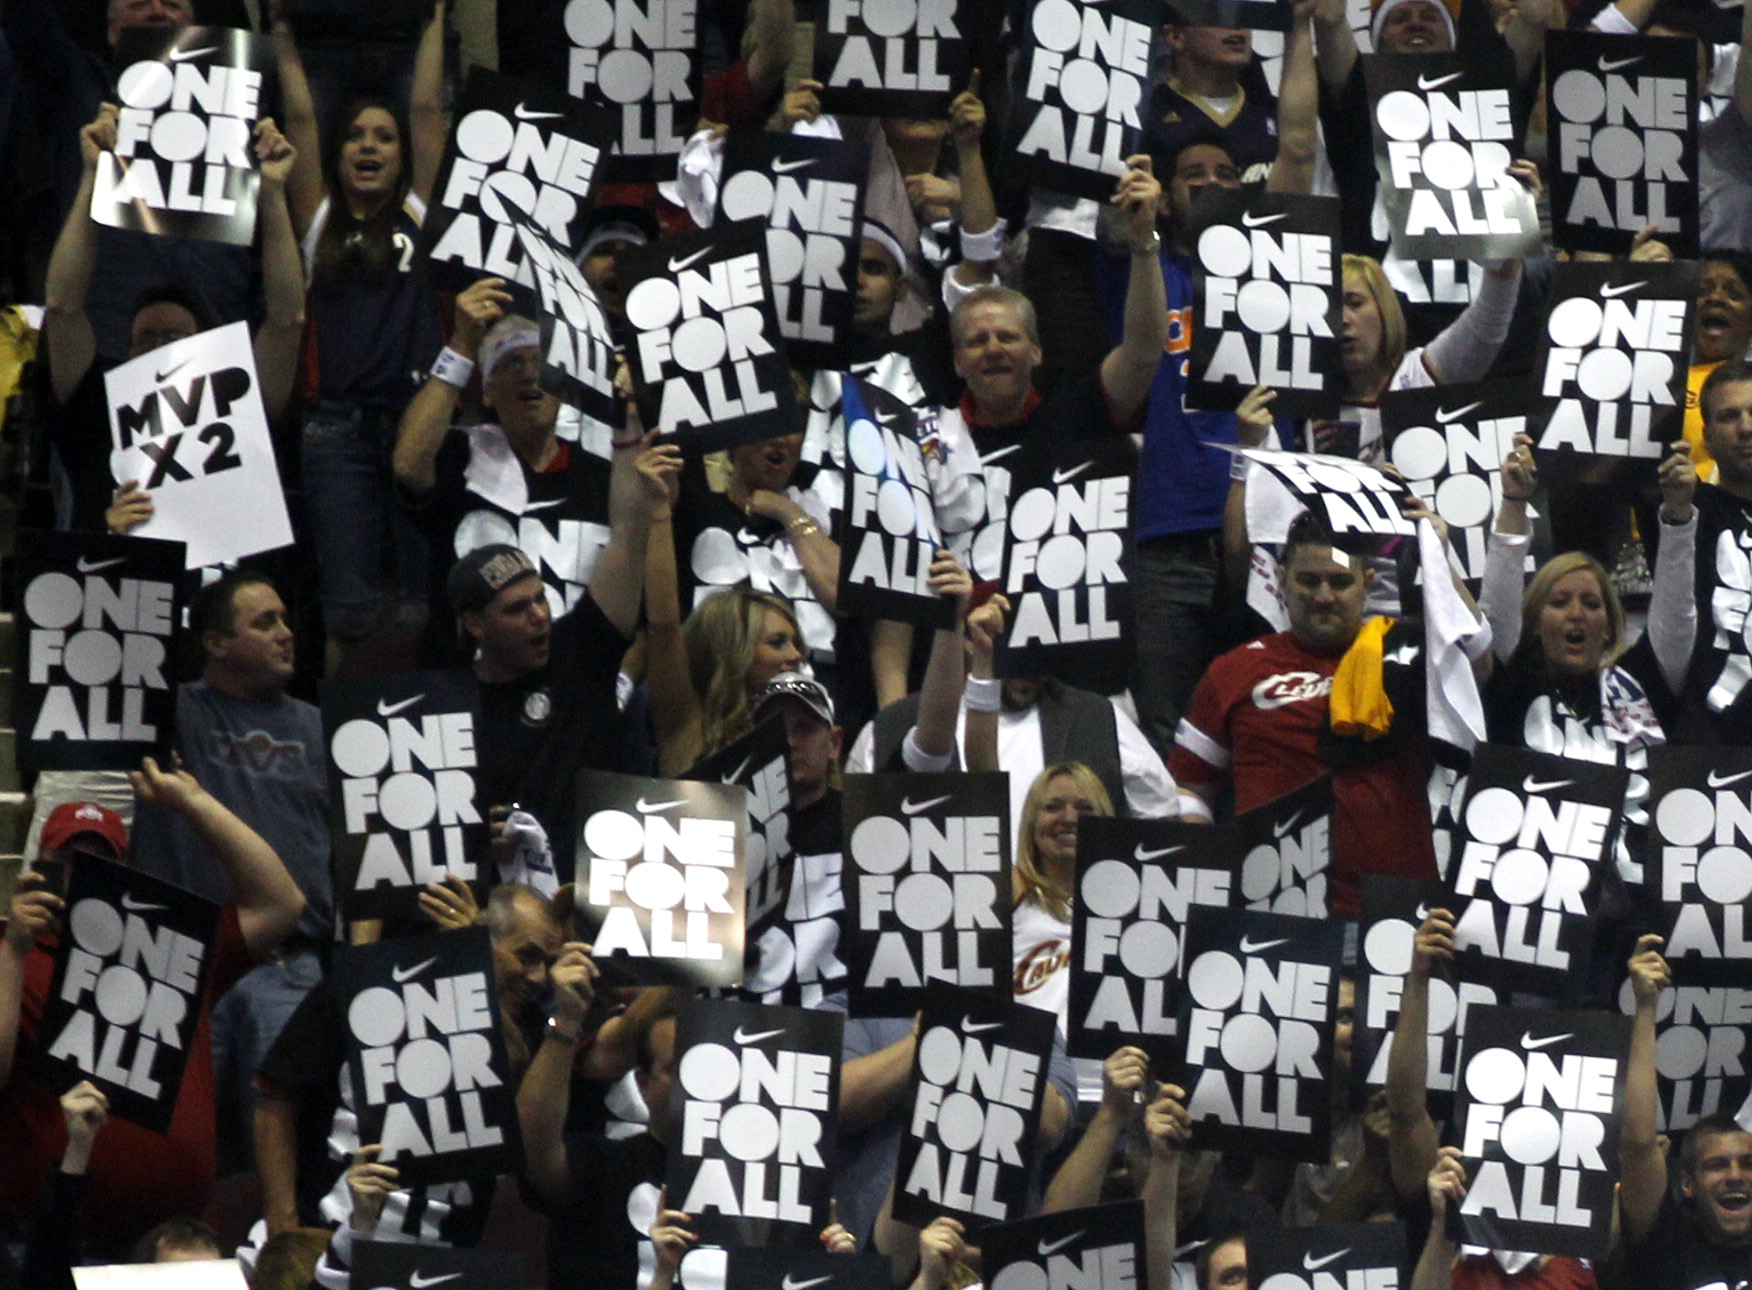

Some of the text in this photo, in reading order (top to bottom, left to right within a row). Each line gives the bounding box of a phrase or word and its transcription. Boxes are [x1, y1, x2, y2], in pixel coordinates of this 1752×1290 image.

[1032, 0, 1154, 77] ONE
[119, 60, 262, 119] ONE
[1027, 44, 1145, 129] FOR
[118, 107, 253, 169] FOR
[1021, 103, 1132, 180] ALL
[116, 157, 240, 218] ALL
[1198, 225, 1333, 286] ONE
[626, 252, 766, 331] ONE
[1203, 275, 1334, 339] FOR
[1548, 297, 1687, 351] ONE
[637, 301, 776, 384] FOR
[1207, 329, 1329, 392] ALL
[1543, 346, 1678, 405] FOR
[117, 367, 250, 451] MVP
[657, 360, 779, 436] ALL
[1539, 398, 1665, 458] ALL
[1011, 474, 1130, 541] ONE
[1010, 526, 1128, 593] FOR
[24, 572, 172, 634] ONE
[1009, 585, 1120, 648] ALL
[27, 627, 168, 690] FOR
[29, 685, 160, 743] ALL
[585, 811, 735, 867] ONE
[589, 858, 733, 915] FOR
[72, 899, 206, 995] ONE
[592, 907, 725, 962] ALL
[59, 946, 191, 1051] FOR
[349, 971, 493, 1048] ONE
[1188, 951, 1332, 1022] ONE
[48, 1007, 165, 1102] ALL
[359, 1027, 502, 1105] FOR
[918, 1029, 1040, 1111] ONE
[1187, 1006, 1323, 1080] FOR
[1186, 1066, 1311, 1135] ALL
[1466, 1047, 1618, 1114] ONE
[379, 1091, 503, 1163] ALL
[910, 1080, 1027, 1171] FOR
[1463, 1101, 1609, 1171] FOR
[903, 1140, 1005, 1225] ALL
[1461, 1160, 1595, 1228] ALL
